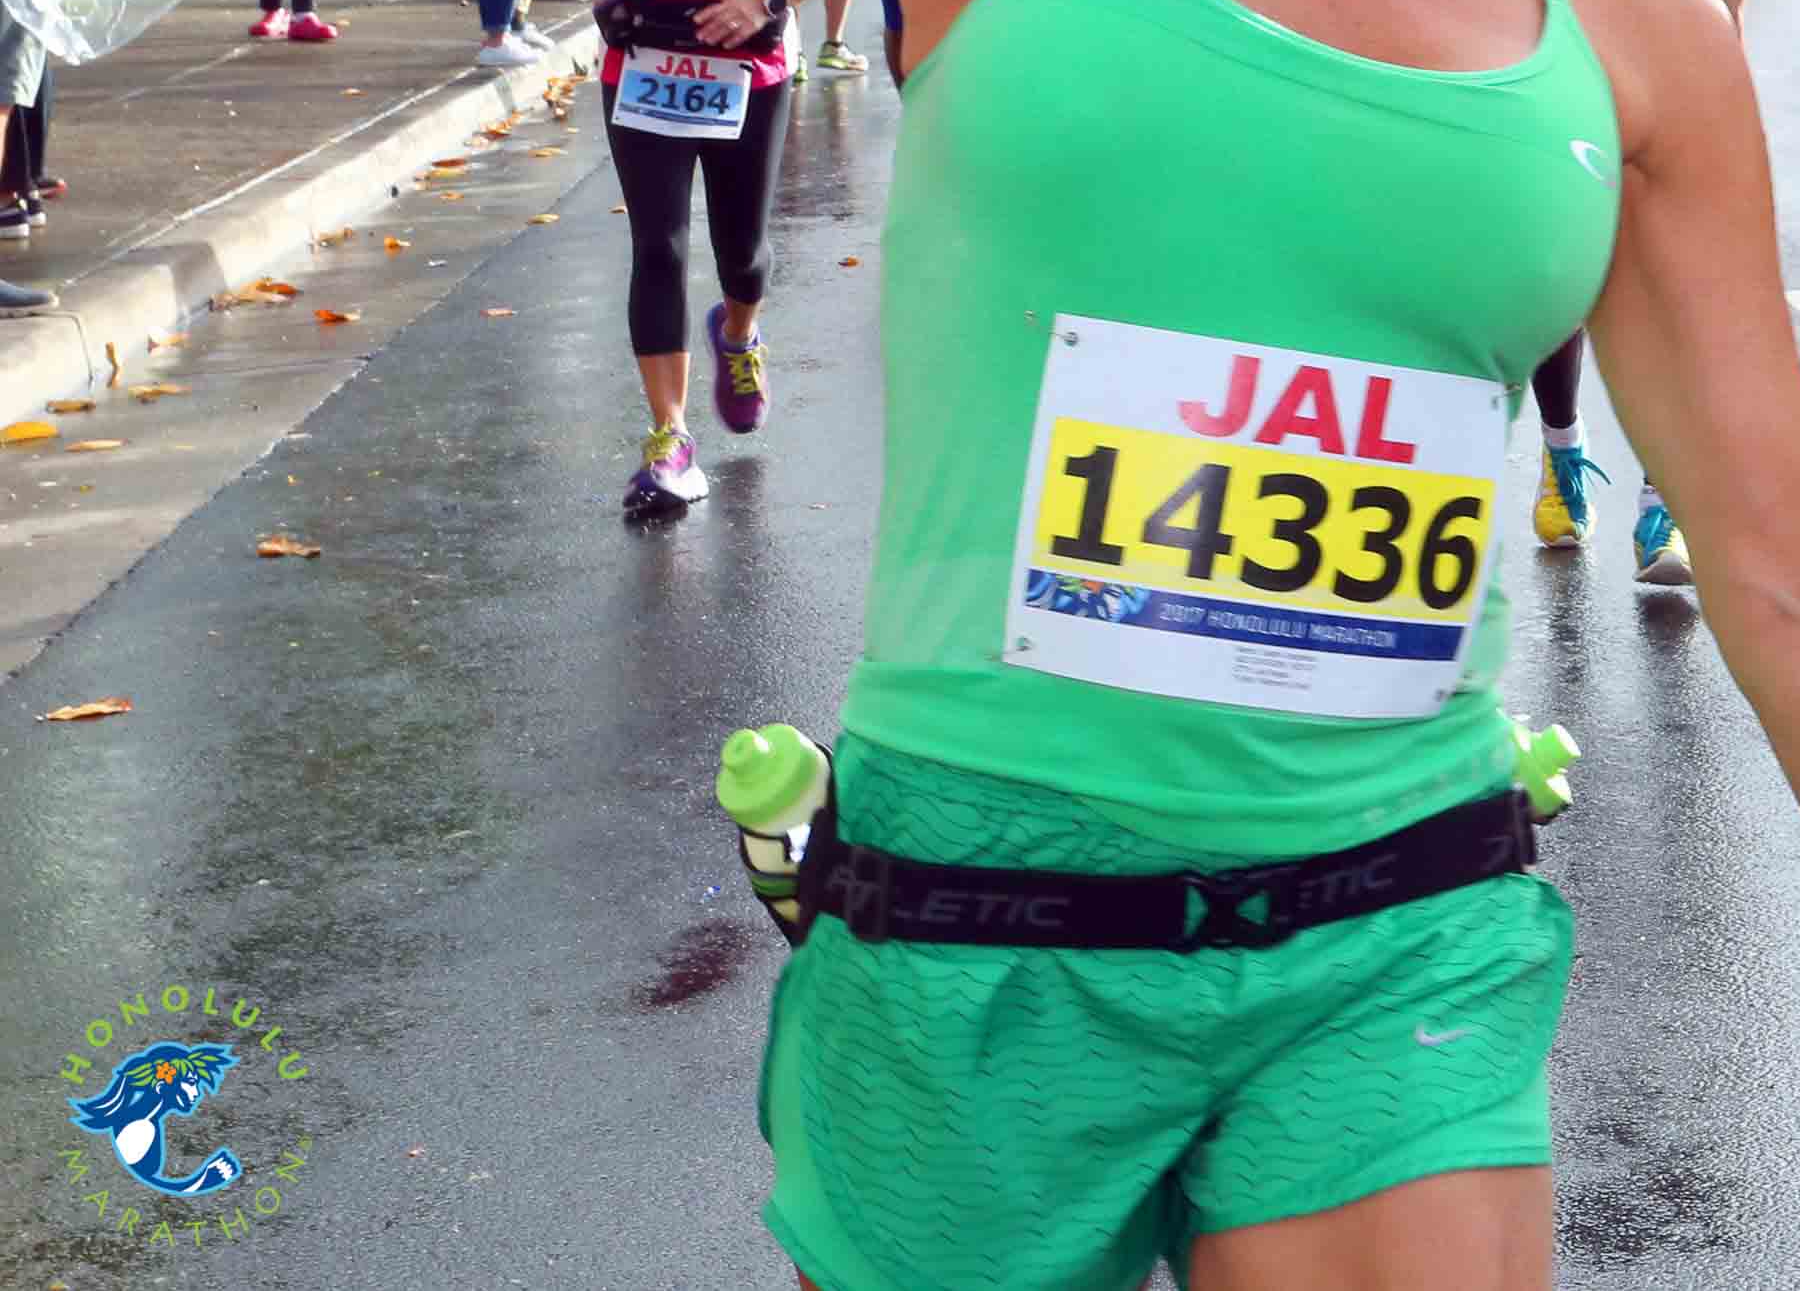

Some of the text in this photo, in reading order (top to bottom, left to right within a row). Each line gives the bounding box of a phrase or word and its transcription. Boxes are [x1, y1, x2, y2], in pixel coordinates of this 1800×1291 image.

[656, 55, 718, 81] JAL
[638, 77, 730, 115] 2164
[1176, 354, 1417, 465] JAL
[1050, 444, 1483, 611] 14336
[1207, 608, 1306, 640] HONOLULU
[1308, 621, 1398, 650] MARATHON
